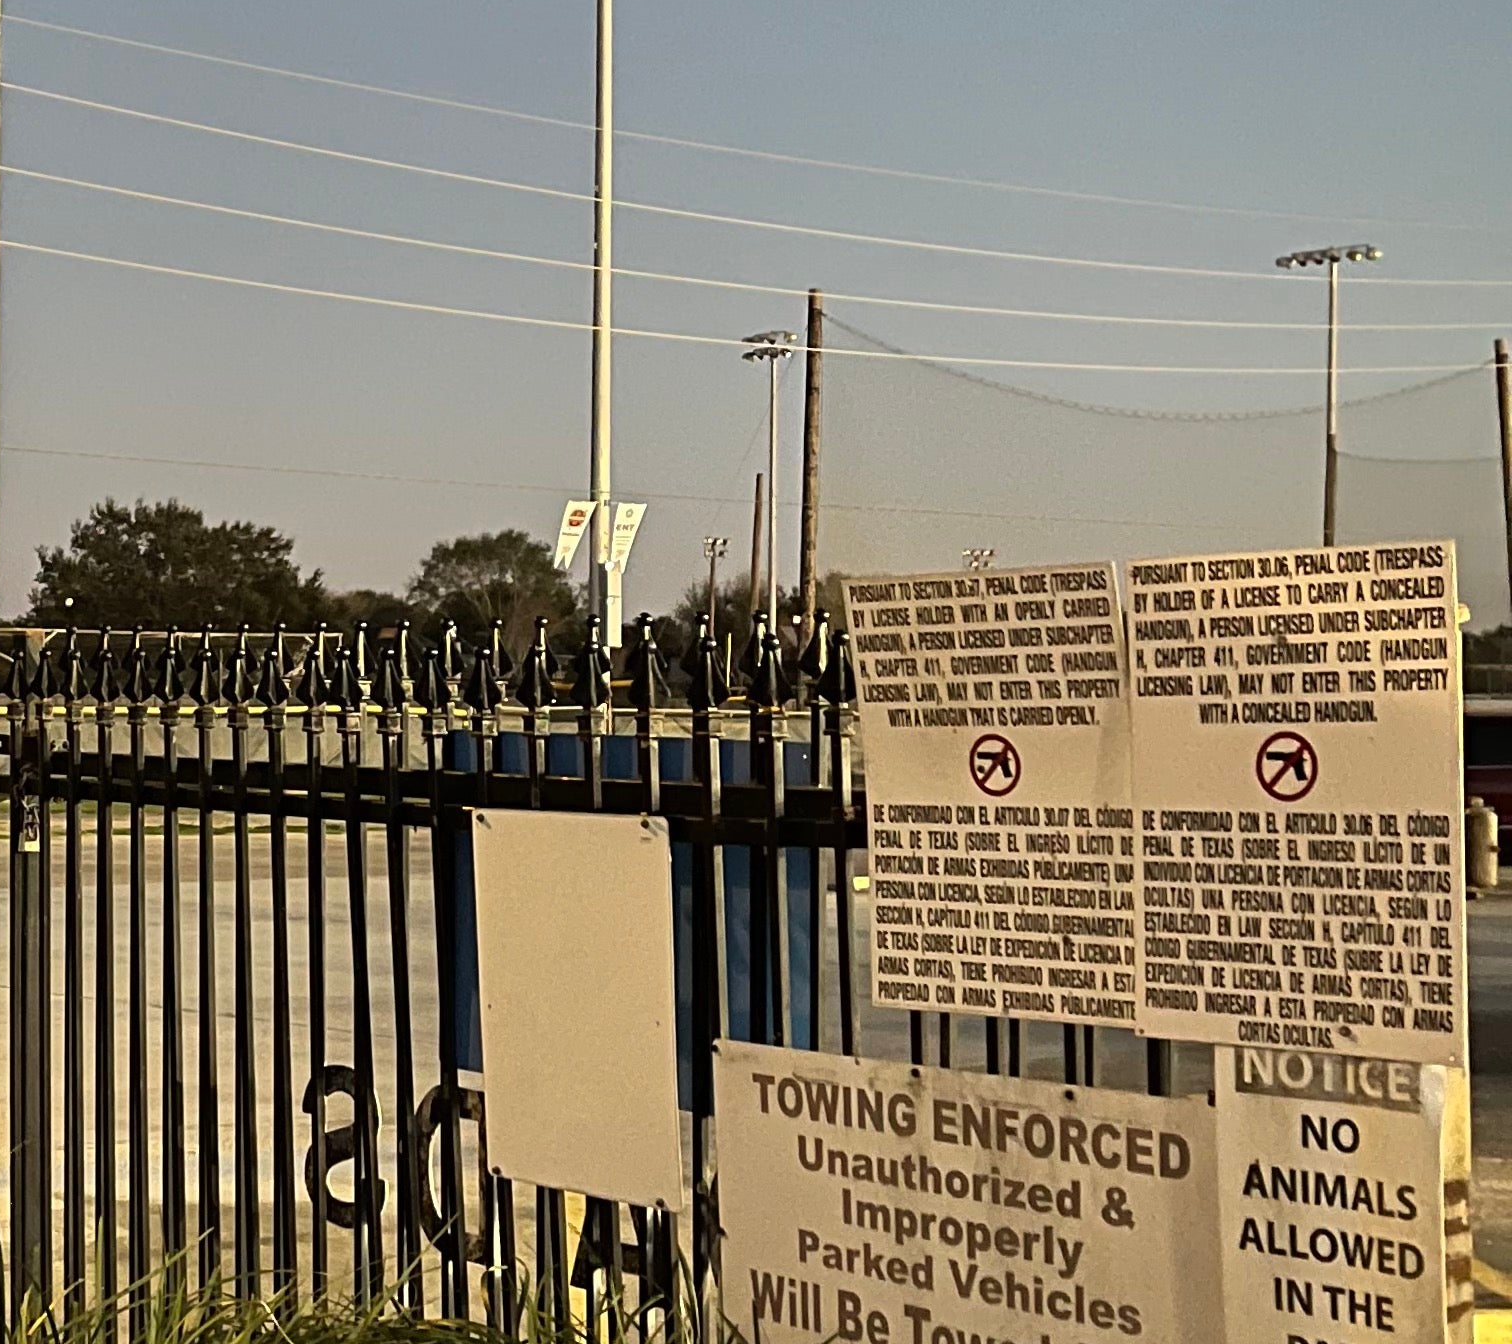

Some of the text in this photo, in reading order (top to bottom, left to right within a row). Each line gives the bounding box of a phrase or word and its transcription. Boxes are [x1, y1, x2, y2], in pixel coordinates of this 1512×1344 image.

[1132, 546, 1443, 585] PURSUANT TO SECTION 30.06, PENAL CODE (TRESPASS
[848, 583, 896, 603] PURSUANT
[898, 582, 911, 601] TO
[912, 580, 953, 600] SECTION
[985, 576, 1017, 596] PENAL
[1019, 574, 1048, 594] CODE
[1049, 570, 1107, 594] (TRESPASS
[1134, 576, 1445, 613] BY HOLDER OF A LICENSE TO CARRY A CONCEALED
[852, 597, 1110, 628] BY LICENSE HOLDER WITH AN OPENLY CARRIED
[1198, 618, 1206, 638] A
[1209, 616, 1254, 638] PERSON
[1257, 613, 1314, 636] LICENSED
[1318, 611, 1359, 633] UNDER
[1364, 606, 1446, 631] SUBCHAPTER
[908, 632, 917, 651] A
[917, 631, 956, 650] PERSON
[958, 629, 1005, 649] LICENSED
[1007, 627, 1043, 647] UNDER
[1045, 624, 1114, 646] SUBCHAPTER
[1154, 646, 1206, 668] CHAPTER
[1213, 646, 1238, 668] 411,
[1246, 642, 1327, 665] GOVERNMENT
[1337, 640, 1371, 662] CODE
[1380, 638, 1447, 663] (HANDGUN
[874, 658, 918, 677] CHAPTER
[1025, 653, 1055, 673] CODE
[1061, 651, 1118, 674] (HANDGUN
[1137, 668, 1448, 698] LICENSING LAW), MAY NOT ENTER THIS PROPERTY
[862, 683, 910, 703] LICENSING
[946, 682, 968, 701] MAY
[973, 681, 993, 701] NOT
[999, 680, 1032, 700] ENTER
[1037, 679, 1062, 699] THIS
[1066, 678, 1119, 698] PROPERTY
[887, 708, 912, 727] WITH
[914, 708, 922, 727] A
[922, 707, 968, 726] HANDGUN
[969, 707, 994, 726] THAT
[996, 707, 1008, 726] IS
[1009, 706, 1054, 726] CARRIED
[1199, 700, 1377, 723] WITH A CONCEALED HANDGUN.
[1244, 1049, 1412, 1102] NOTICE
[752, 1073, 1190, 1180] TOWING ENFORCED
[1301, 1114, 1360, 1154] NO
[797, 1135, 1136, 1229] Unauthorized &
[1242, 1163, 1417, 1221] ANIMALS
[842, 1188, 1084, 1279] Improperly
[1239, 1218, 1425, 1280] ALLOWED
[749, 1269, 821, 1333] Will
[798, 1228, 1143, 1336] Parked Vehicles
[1274, 1277, 1395, 1333] IN THE
